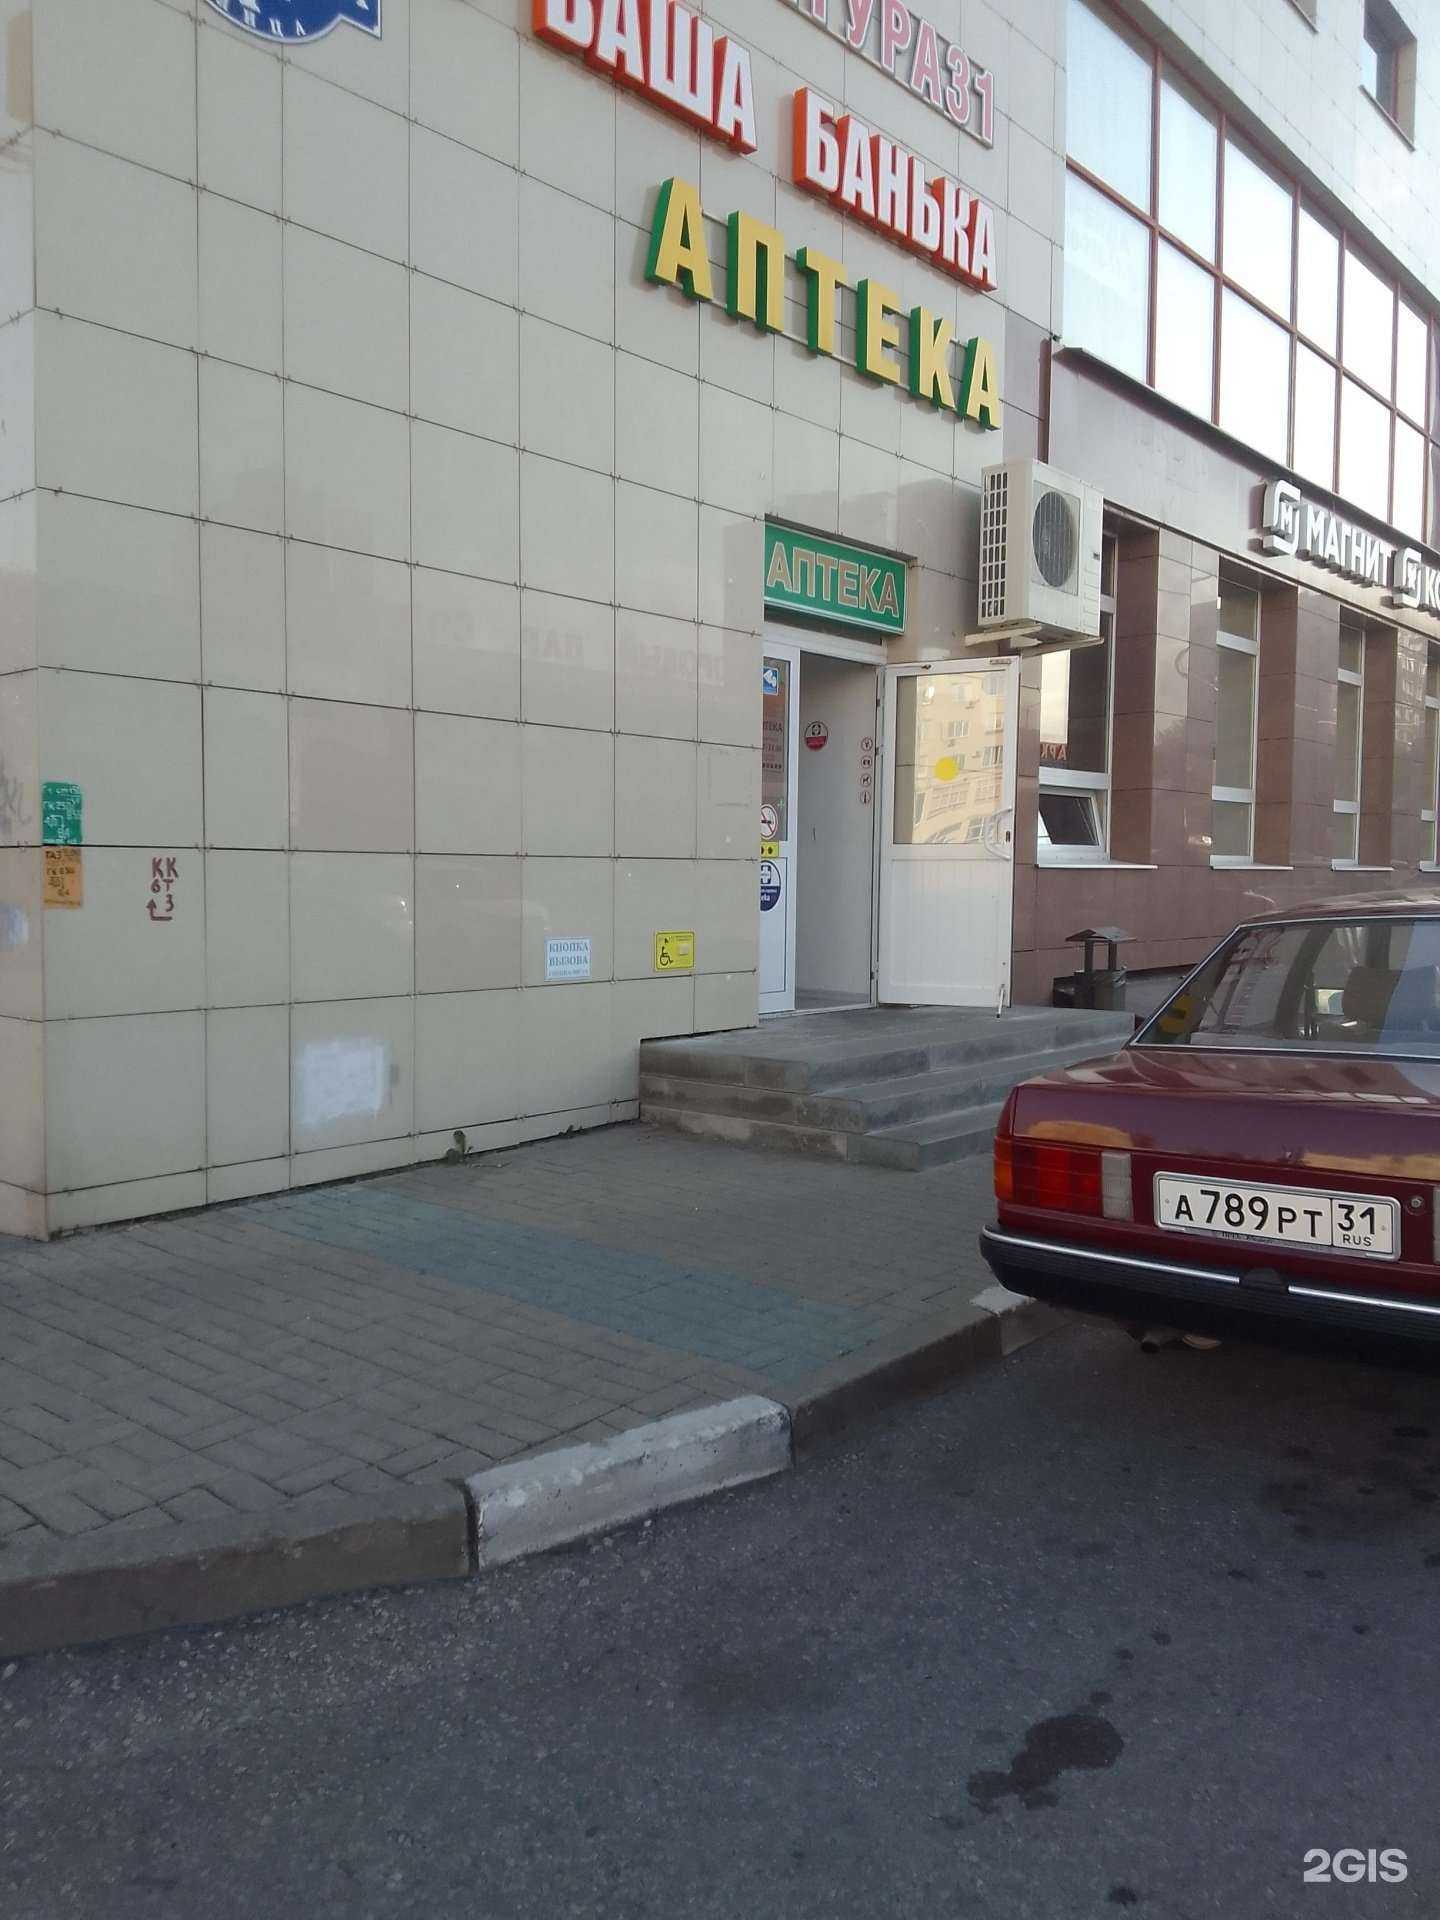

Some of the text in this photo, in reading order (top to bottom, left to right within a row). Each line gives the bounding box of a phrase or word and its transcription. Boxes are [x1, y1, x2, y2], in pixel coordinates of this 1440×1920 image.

[794, 87, 998, 290] БАНЬКА
[646, 176, 1002, 430] АПТЕКА
[1307, 503, 1391, 588] МАГНИТ
[766, 541, 899, 618] АПТЕКА
[549, 942, 589, 952] КНОПКА
[549, 956, 588, 966] ВЫЗОВА
[1338, 1203, 1376, 1235] 31
[1342, 1233, 1373, 1247] RUS
